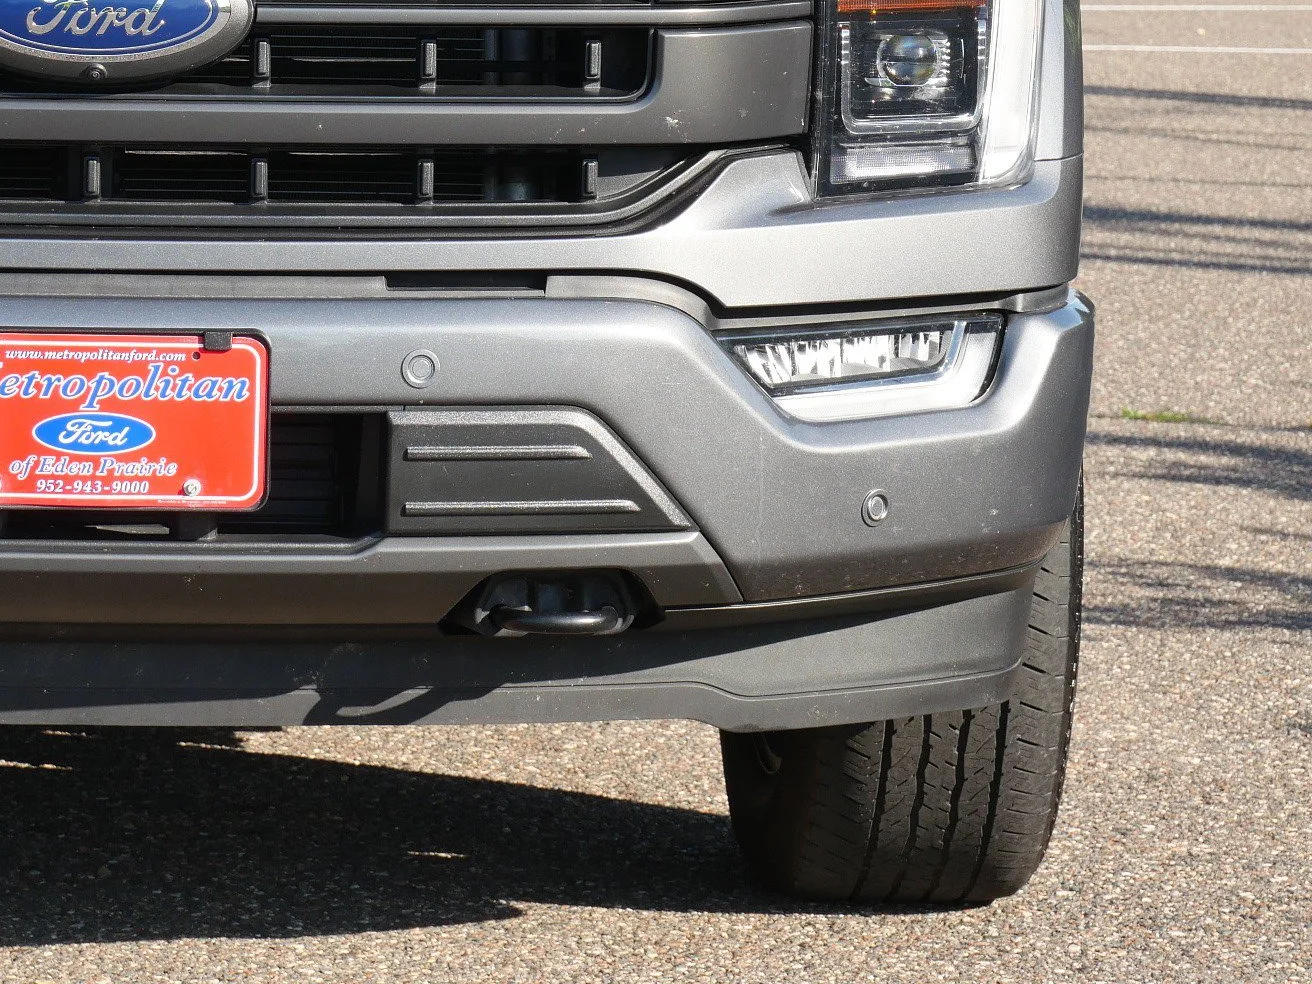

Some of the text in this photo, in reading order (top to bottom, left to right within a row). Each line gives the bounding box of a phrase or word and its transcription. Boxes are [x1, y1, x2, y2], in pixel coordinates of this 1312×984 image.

[5, 348, 187, 363] www.metropolitanford.com
[58, 418, 130, 446] Ford
[9, 454, 179, 480] of Eden Prairie
[36, 479, 150, 494] 952-943-9000
